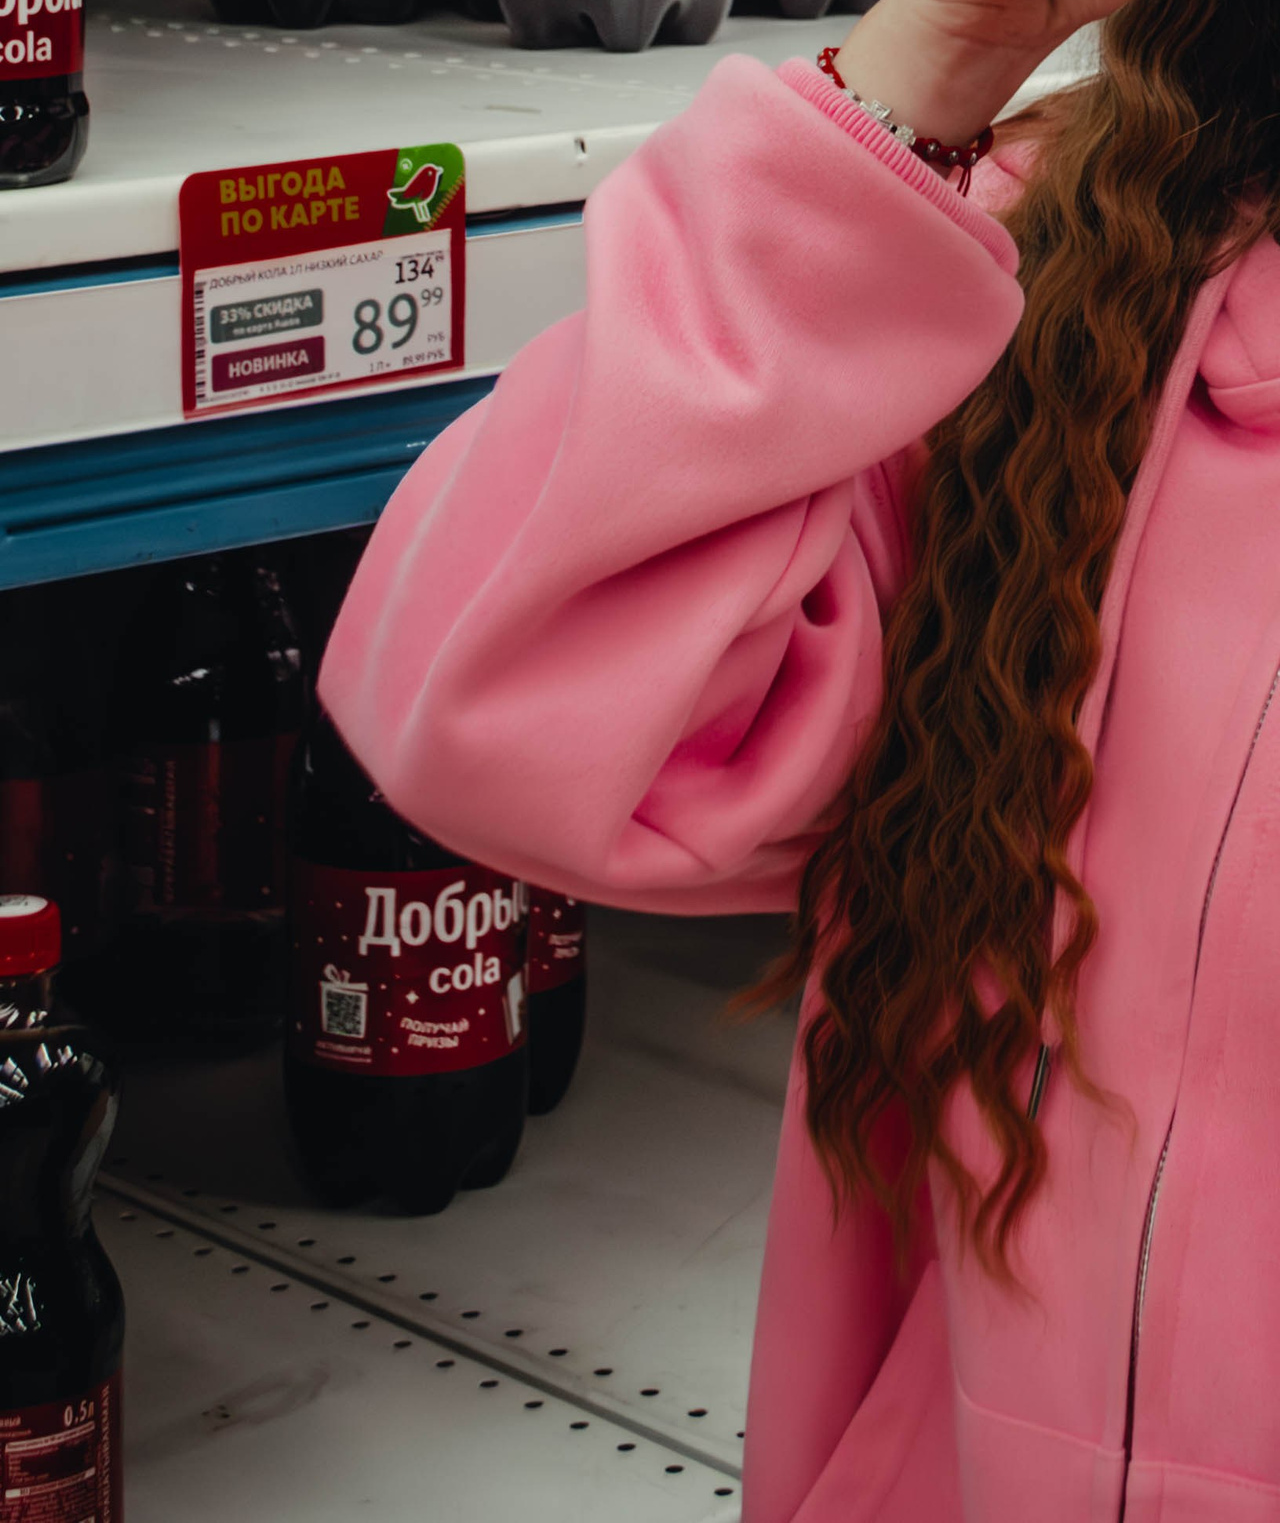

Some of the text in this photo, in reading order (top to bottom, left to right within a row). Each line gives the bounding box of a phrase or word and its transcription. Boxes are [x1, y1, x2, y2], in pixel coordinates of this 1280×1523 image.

[0, 30, 52, 64] ola
[218, 166, 346, 205] ВЫГОДА
[221, 196, 361, 237] ПО КАРТЕ
[208, 270, 256, 291] ДОБРЫЙ
[257, 267, 287, 281] КОЛА
[395, 257, 434, 284] 134
[253, 294, 314, 318] СКИДКА
[352, 287, 444, 355] 89 99
[228, 349, 310, 379] НОВИНКА
[429, 952, 501, 994] cola
